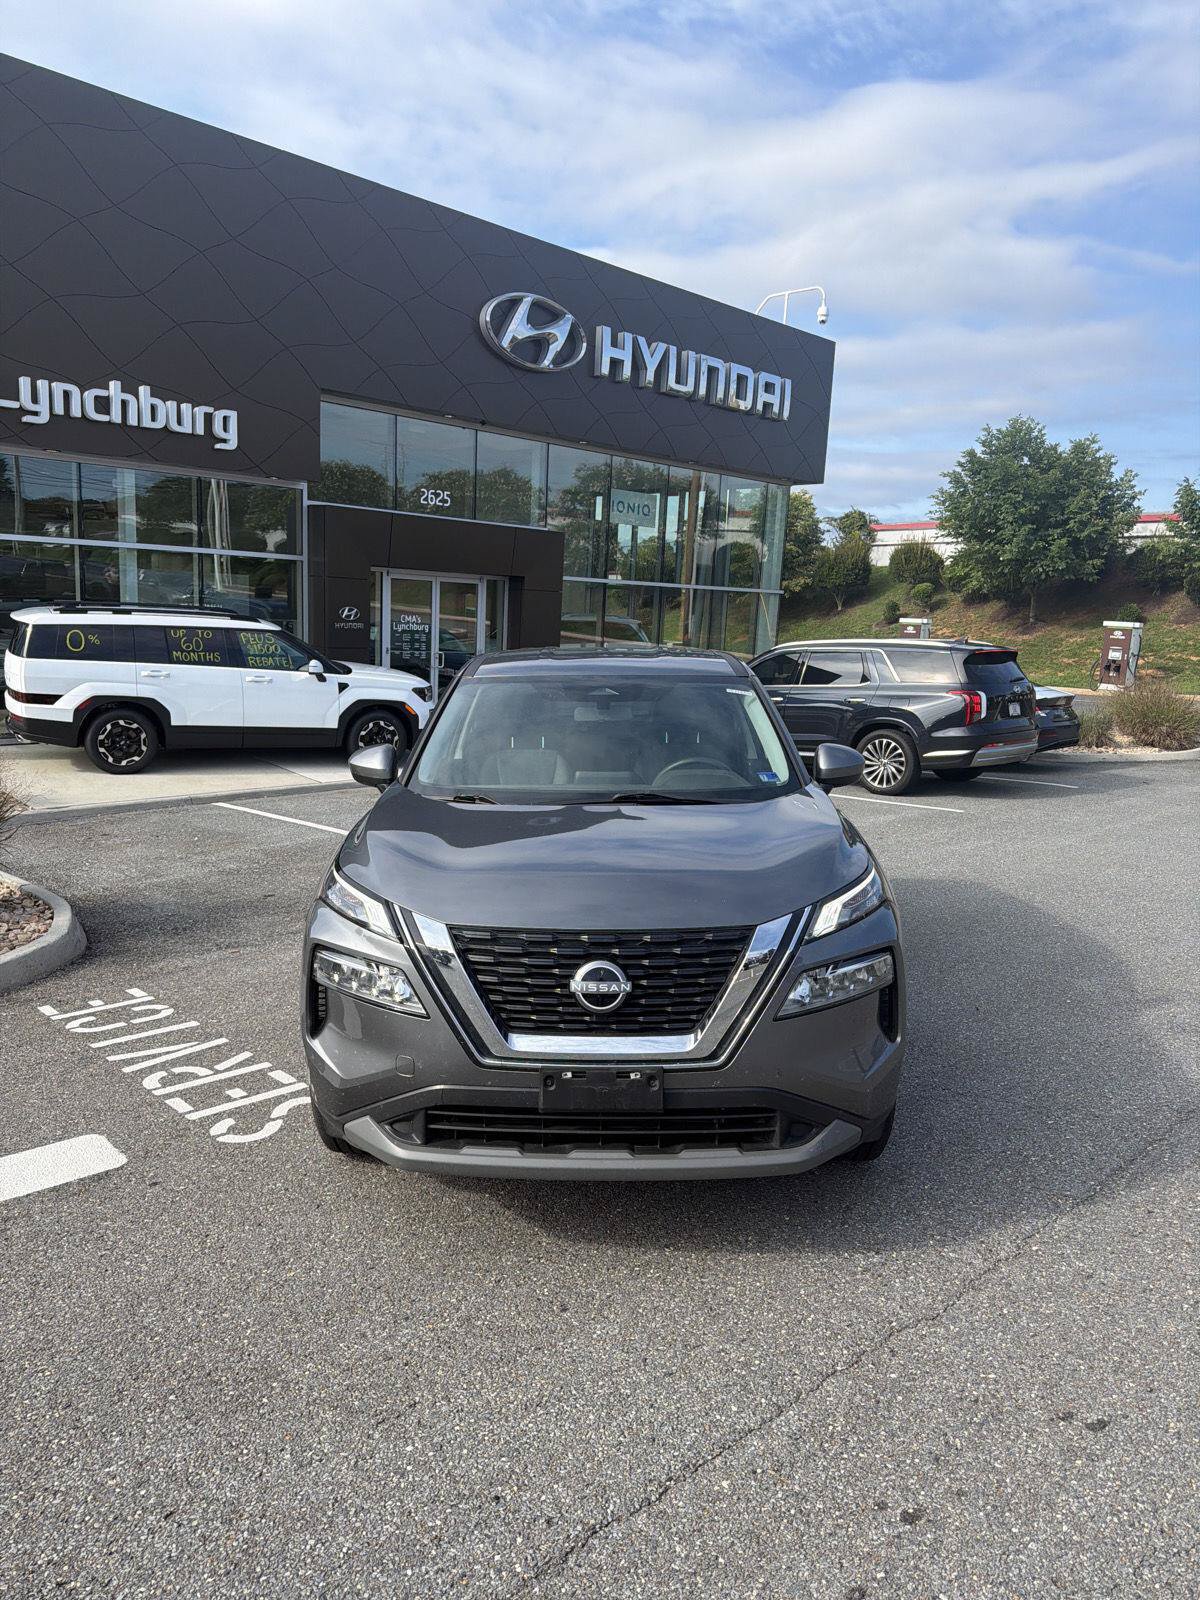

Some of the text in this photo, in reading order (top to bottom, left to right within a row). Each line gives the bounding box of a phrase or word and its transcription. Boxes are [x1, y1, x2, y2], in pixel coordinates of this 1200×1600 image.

[593, 325, 792, 421] HYUNDAI
[420, 488, 451, 507] 2625
[611, 500, 651, 517] IONIQ
[400, 614, 422, 623] CMA's
[334, 622, 364, 630] HYUNDAI
[393, 622, 429, 633] Lynchburg
[170, 629, 213, 639] UP TO
[240, 632, 275, 645] PLUS
[180, 637, 203, 652] 60
[172, 651, 221, 663] MONTHS
[571, 983, 631, 992] NISSAN
[37, 987, 311, 1143] SERVICE
